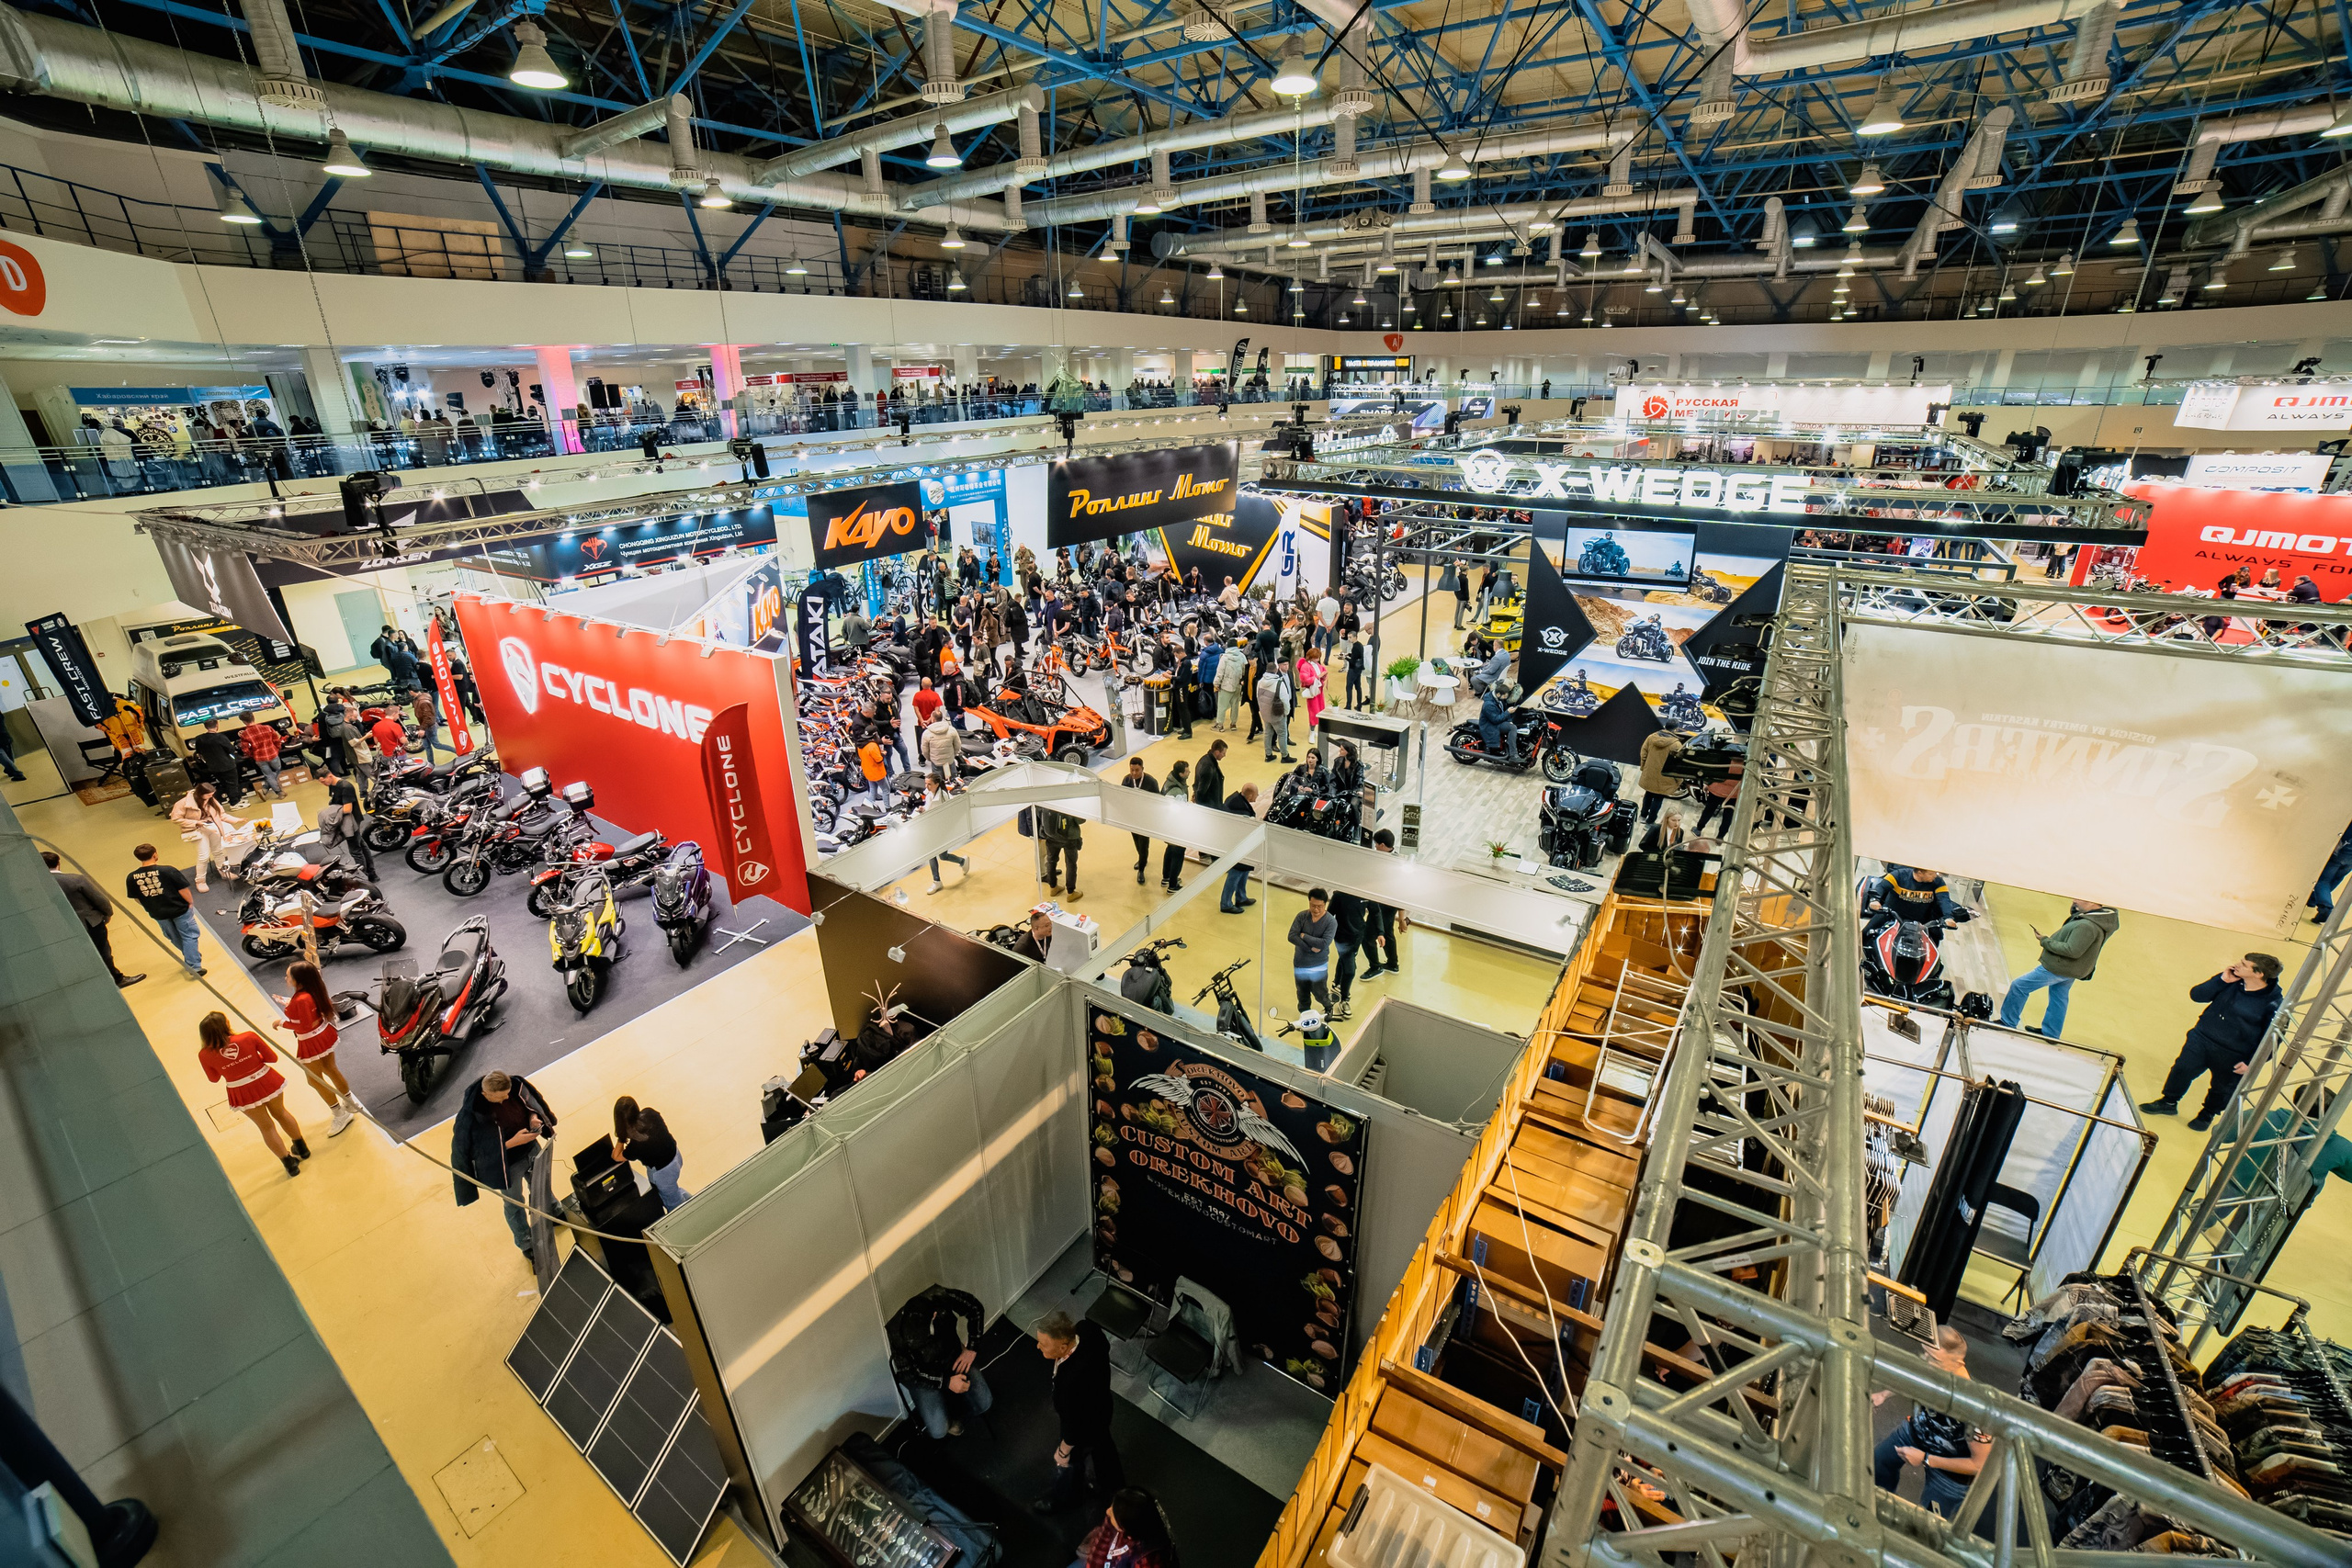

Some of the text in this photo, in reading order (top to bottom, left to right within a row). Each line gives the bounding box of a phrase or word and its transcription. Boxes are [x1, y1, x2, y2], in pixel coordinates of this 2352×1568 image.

[1676, 398, 1739, 407] РУССКАЯ
[2205, 466, 2301, 474] COMPOSIT
[1069, 473, 1229, 518] Роллинг Мото
[1531, 462, 1815, 514] X-WEDGE
[618, 536, 654, 549] CHONGQING
[655, 532, 685, 544] XINGUIZUN
[823, 500, 915, 550] KAYO
[1187, 524, 1252, 558] Мото
[358, 550, 432, 570] ZONSEN
[582, 560, 613, 571] XGZ
[2195, 550, 2292, 569] ALWAYS
[753, 581, 781, 642] KAYO
[919, 569, 931, 628] TAKI
[171, 623, 214, 633] Роллинг
[807, 596, 827, 681] ATAKI
[49, 637, 79, 681] CREW
[1537, 648, 1567, 656] X-WEDGE
[1697, 656, 1753, 671] JOIN THE RIDE
[74, 665, 91, 691] MOSCOW
[432, 641, 461, 726] CYCLONE
[74, 684, 101, 720] FAST
[176, 695, 277, 722] FAST CREW
[541, 661, 713, 745] CYCLONE
[716, 734, 752, 854] CYCLONE
[133, 872, 146, 880] MAKE
[221, 1055, 253, 1070] CYCLONE
[1186, 1066, 1247, 1100] OREKHOVO
[1175, 1110, 1254, 1157] CUSTOM ART
[1120, 1125, 1313, 1230] CUSTOM ART
[1129, 1149, 1300, 1244] OREKHOVO
[1183, 1191, 1231, 1221] EST 1997
